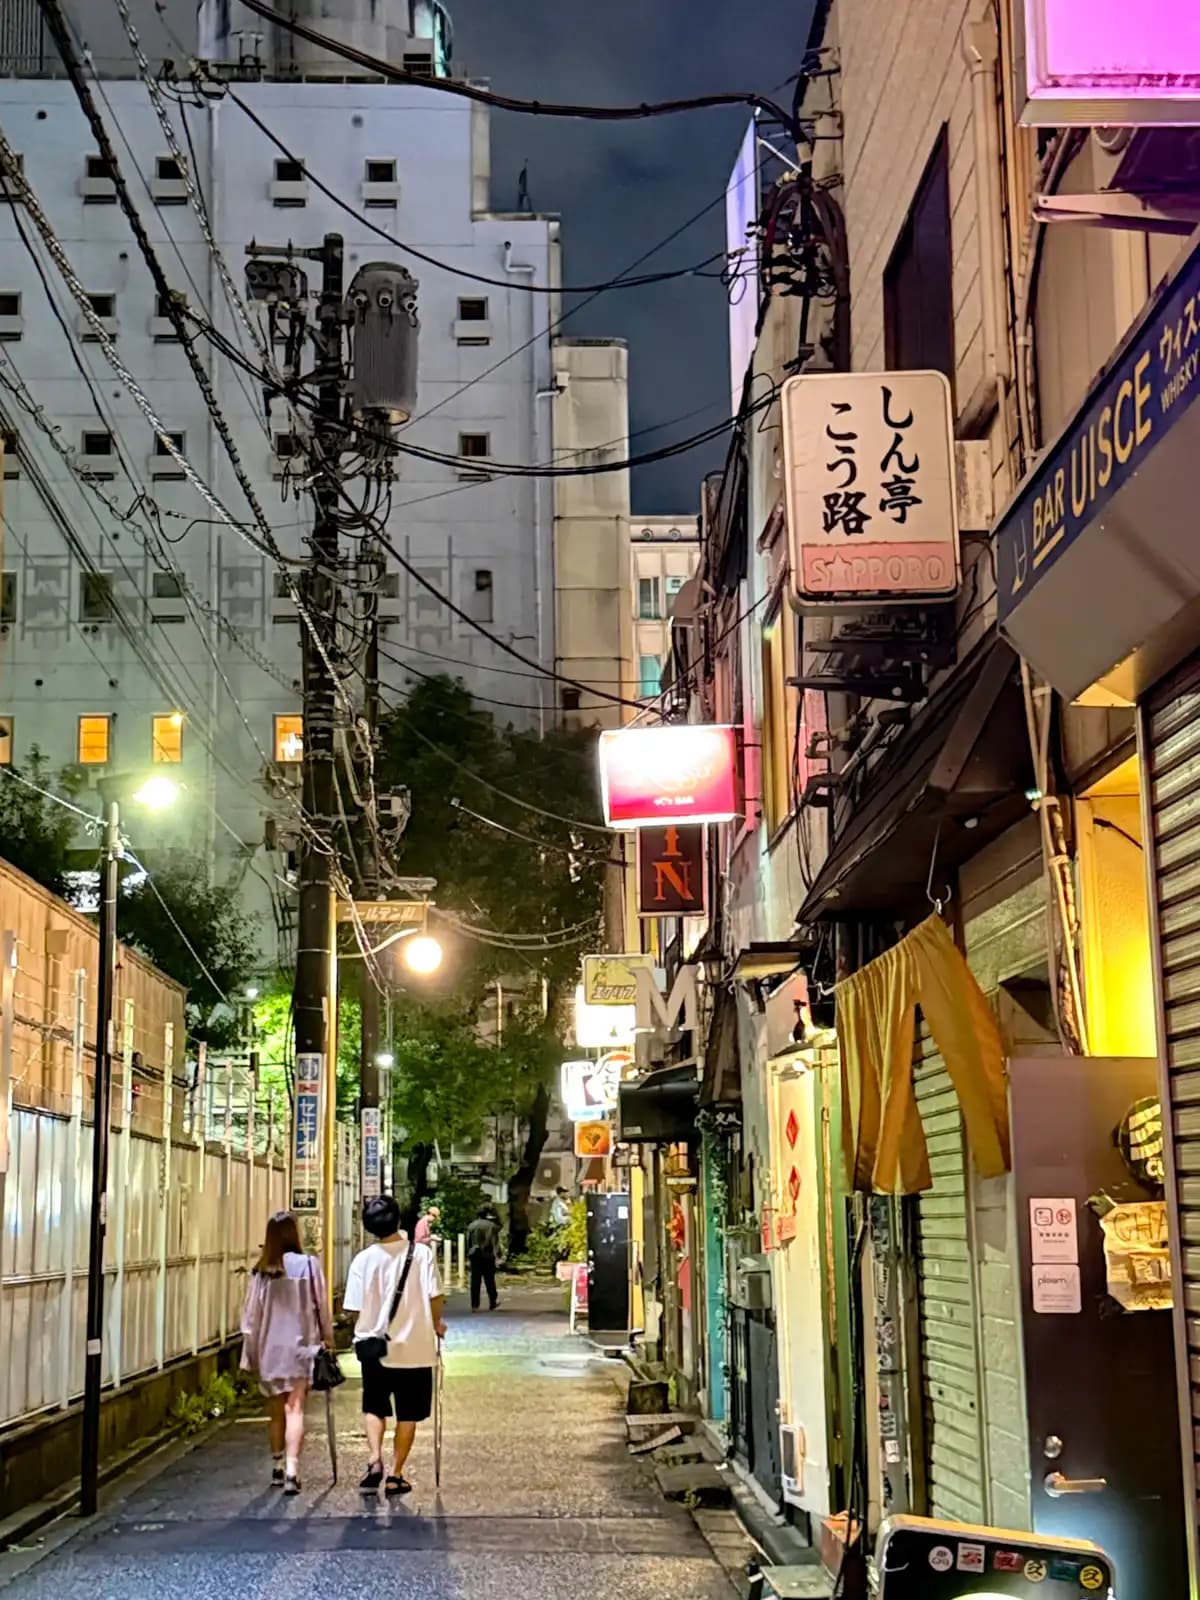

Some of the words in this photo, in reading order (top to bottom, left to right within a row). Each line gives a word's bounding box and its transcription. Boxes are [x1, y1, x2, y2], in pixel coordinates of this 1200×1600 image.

[1160, 347, 1200, 413] WHISKY
[822, 402, 872, 536] こう路
[879, 385, 923, 524] しん亭
[1033, 467, 1065, 550] BAR
[1070, 350, 1152, 518] UISCE
